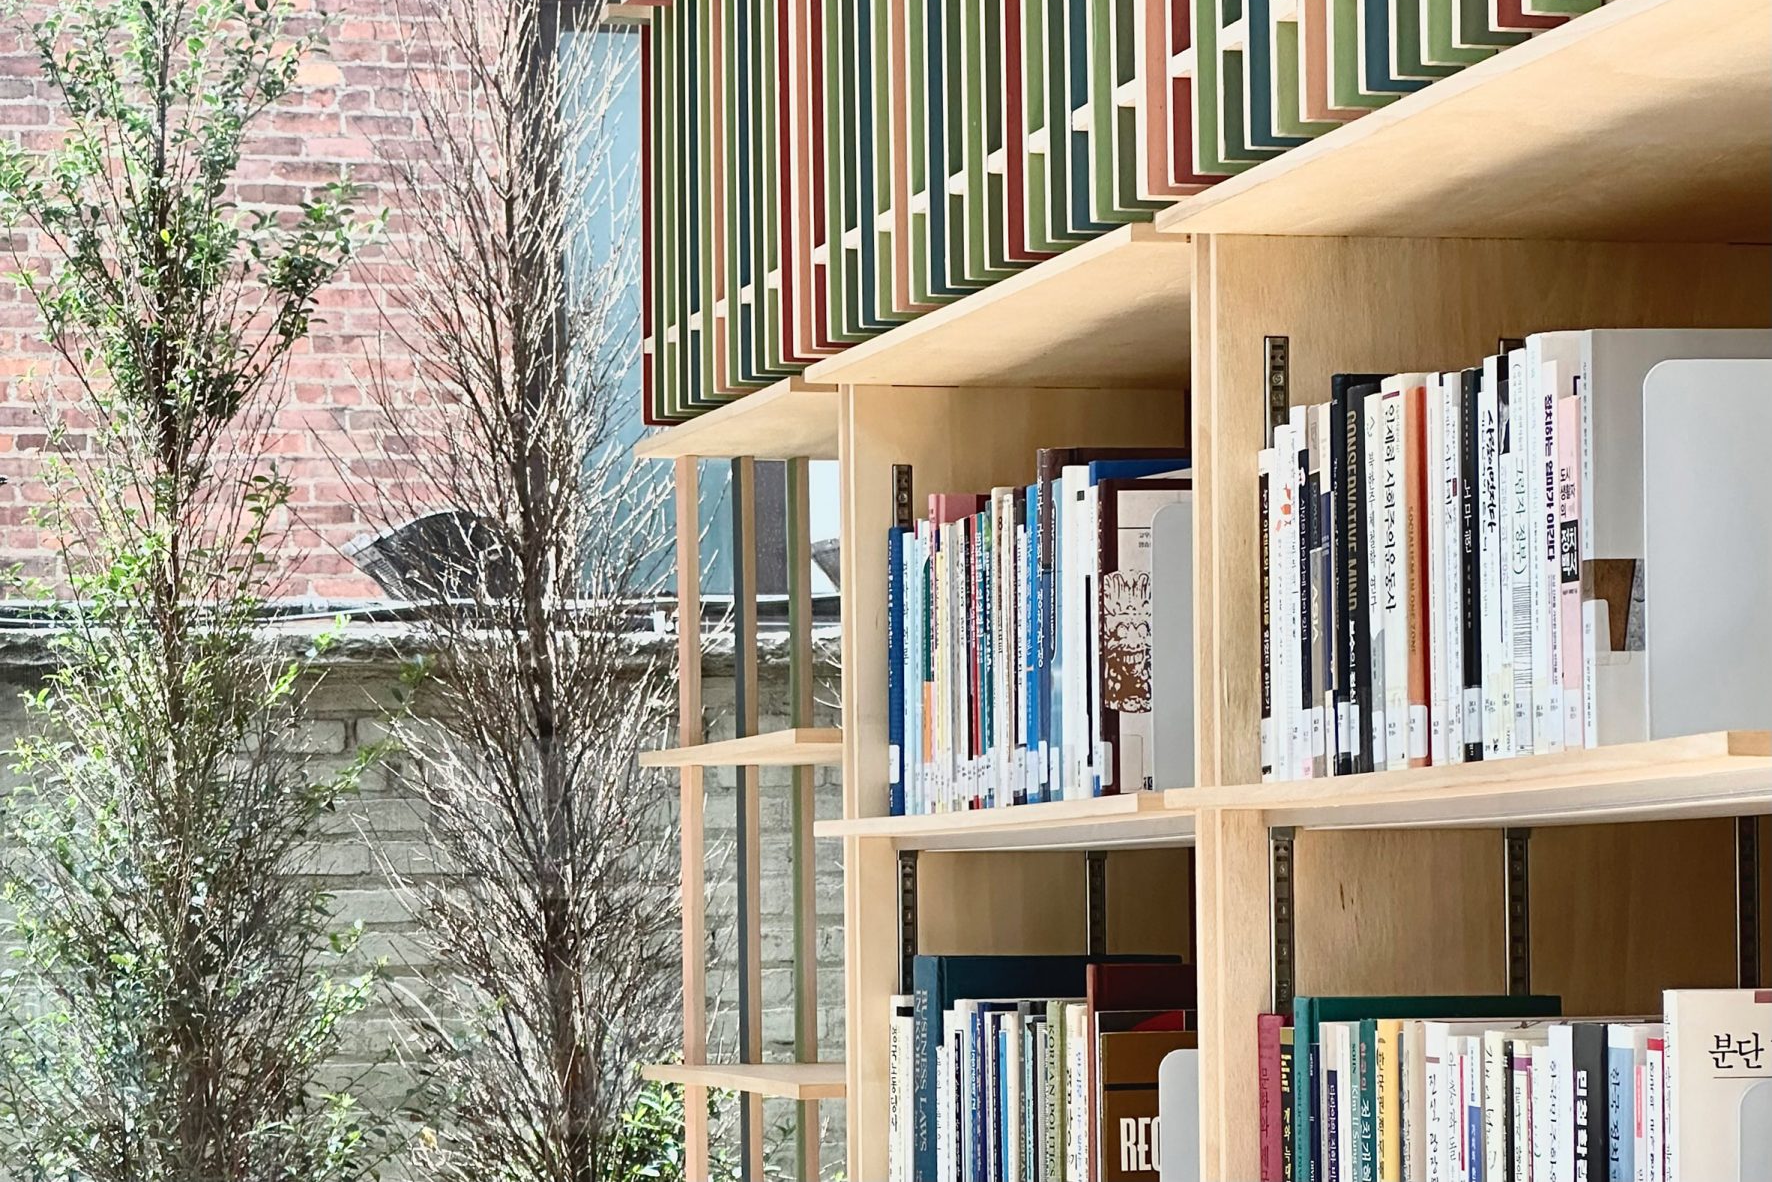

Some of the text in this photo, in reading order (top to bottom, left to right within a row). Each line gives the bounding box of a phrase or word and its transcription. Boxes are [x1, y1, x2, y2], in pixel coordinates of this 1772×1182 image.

[1514, 458, 1526, 516] 그림자
[1544, 393, 1555, 562] 정치하는 엄마가 이긴다
[1347, 410, 1358, 611] CONSERVATIVE MIND
[1408, 505, 1416, 574] SOCIALISM
[1312, 584, 1320, 644] ASIA
[1409, 623, 1417, 656] ZONE
[915, 989, 921, 1013] IN
[919, 989, 928, 1153] BUSINESS LAWS
[1048, 1023, 1056, 1097] KOREAN
[1708, 1032, 1765, 1069] 분단
[1351, 1084, 1359, 1112] Kim
[1609, 1065, 1621, 1164] 한국 정치
[1048, 1103, 1056, 1178] POLITICS
[1351, 1129, 1360, 1165] Sung
